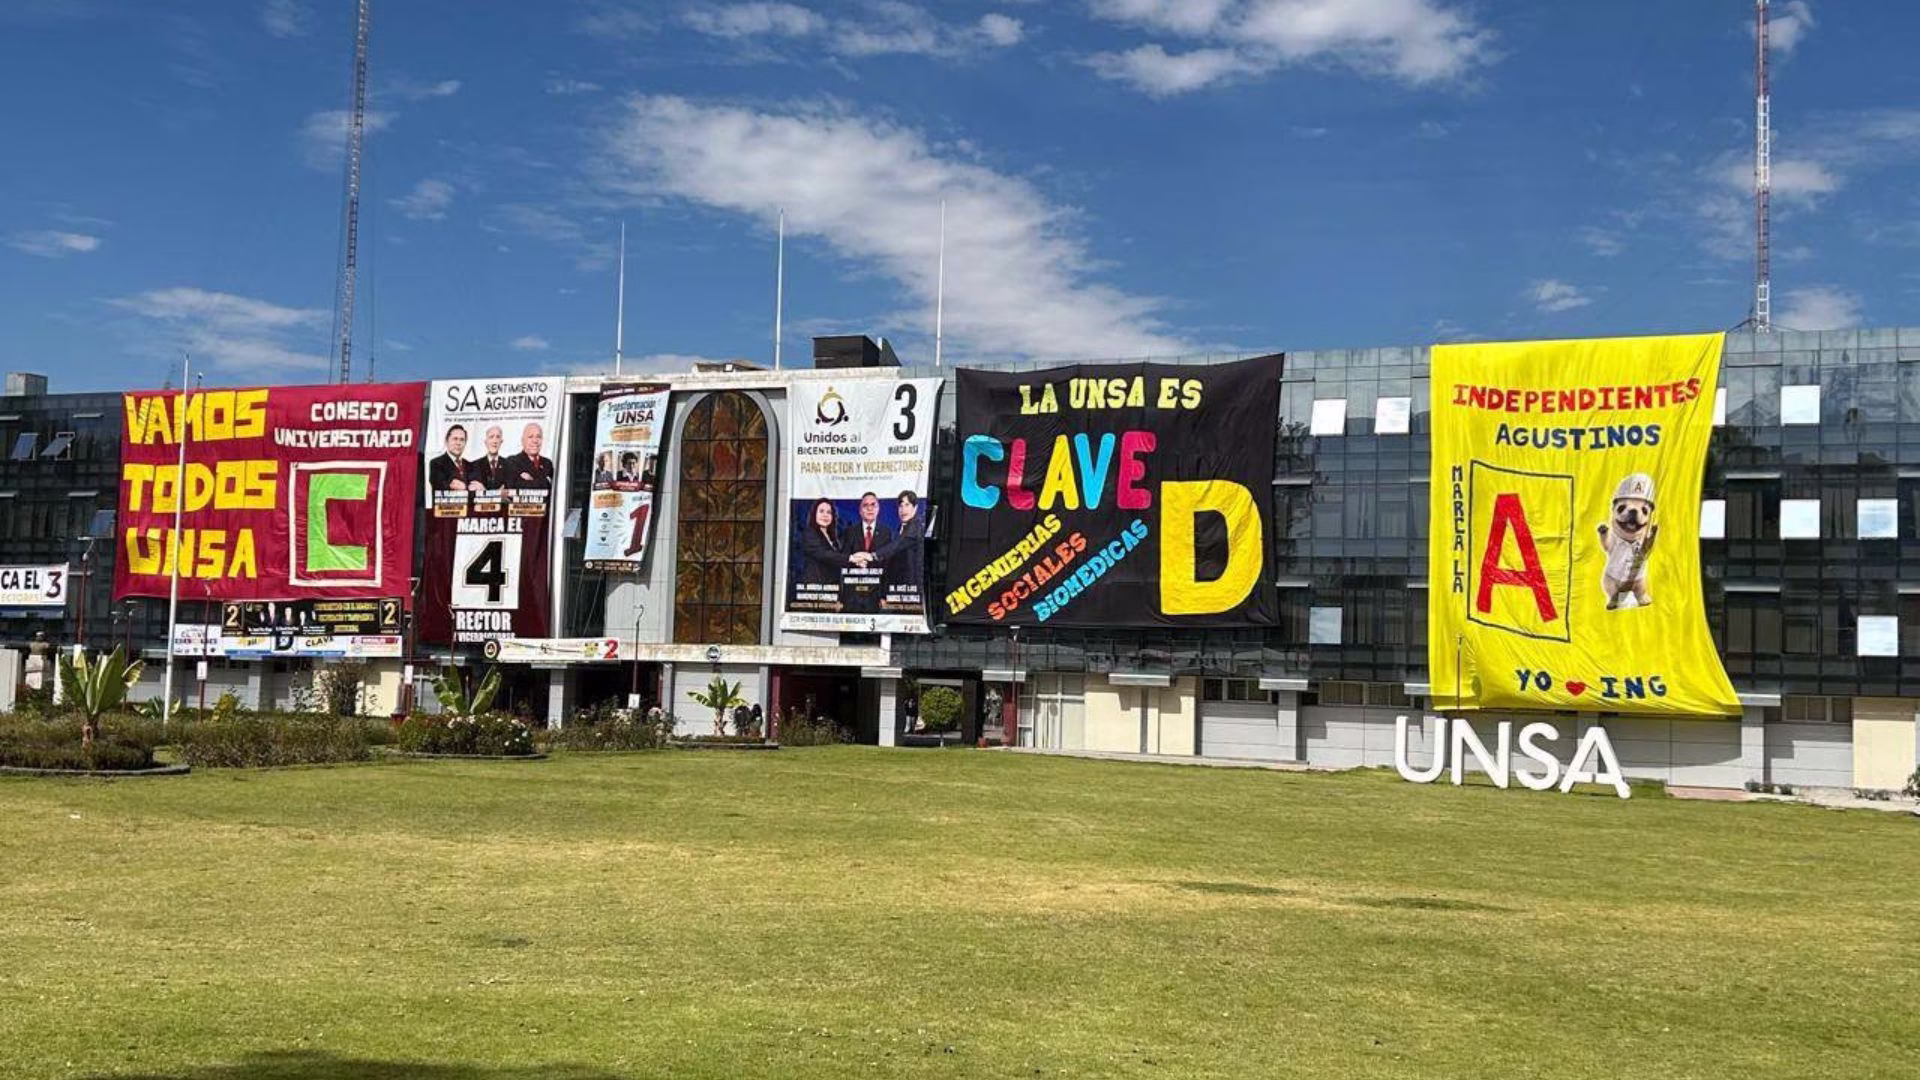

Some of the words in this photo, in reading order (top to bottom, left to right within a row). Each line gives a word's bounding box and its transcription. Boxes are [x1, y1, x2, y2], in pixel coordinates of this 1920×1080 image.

[445, 385, 480, 412] SA
[484, 395, 547, 411] AGUSTINO
[485, 382, 547, 394] SENTIMIENTO
[1018, 383, 1058, 415] LA
[1069, 376, 1145, 409] UNSA
[1157, 378, 1203, 409] ES
[1453, 378, 1701, 413] INDEPENDIENTES
[124, 388, 269, 444] VAMOS
[310, 402, 398, 422] CONSEJO
[614, 410, 654, 424] UNSA
[893, 383, 917, 441] 3
[274, 429, 412, 448] UNIVERSITARIO
[797, 446, 868, 456] BICENTENARIO
[804, 432, 847, 443] Unidos
[1495, 424, 1661, 450] AGUSTINOS
[800, 461, 821, 474] PARA
[823, 461, 855, 474] RECTOR
[856, 462, 861, 473] Y
[863, 460, 923, 473] VICERRECTORES
[961, 431, 1157, 510] CLAVE
[123, 460, 278, 513] TODOS
[1635, 482, 1642, 493] A
[307, 474, 369, 571] C
[1452, 466, 1463, 551] MARCA
[457, 518, 504, 533] MARCA
[507, 518, 523, 532] EL
[624, 504, 649, 556] 1
[126, 528, 257, 579] UNSA
[1160, 480, 1262, 615] D
[1476, 493, 1558, 622] A
[465, 541, 506, 601] 4
[946, 514, 1061, 614] INGENIERIAS
[988, 531, 1087, 620] SOCIALES
[1033, 519, 1148, 622] BIOMEDICAS
[1453, 559, 1463, 592] LA
[24, 571, 39, 589] EL
[46, 571, 62, 598] 3
[226, 605, 238, 627] 2
[383, 602, 396, 625] 2
[456, 611, 511, 631] RECTOR
[305, 635, 334, 647] CLAVE
[604, 640, 619, 659] 2
[1516, 669, 1552, 691] YO
[1600, 676, 1667, 699] ING
[1394, 715, 1632, 799] UNSA
